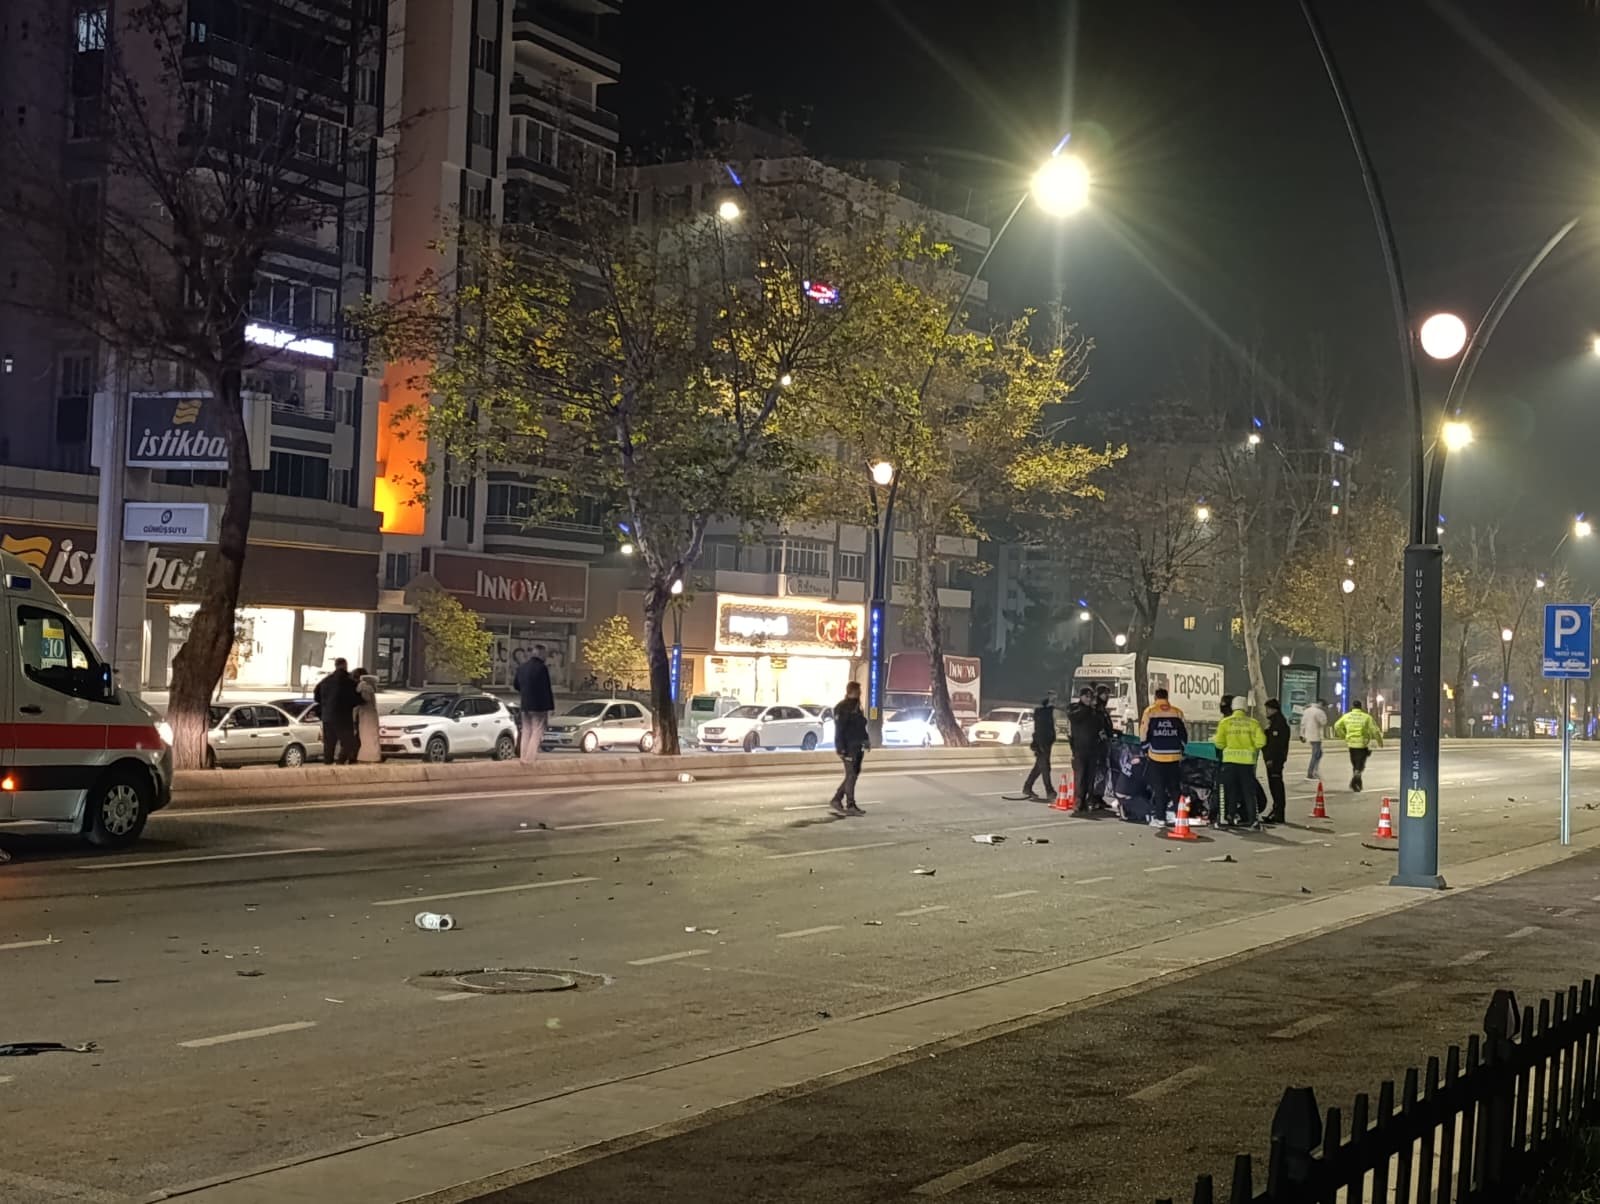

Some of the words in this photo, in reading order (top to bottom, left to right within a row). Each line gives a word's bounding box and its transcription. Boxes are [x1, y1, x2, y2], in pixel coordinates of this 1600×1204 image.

[137, 429, 229, 457] istikba
[476, 570, 548, 602] INNOVA
[1555, 610, 1581, 648] P
[1174, 672, 1220, 699] rapsodi
